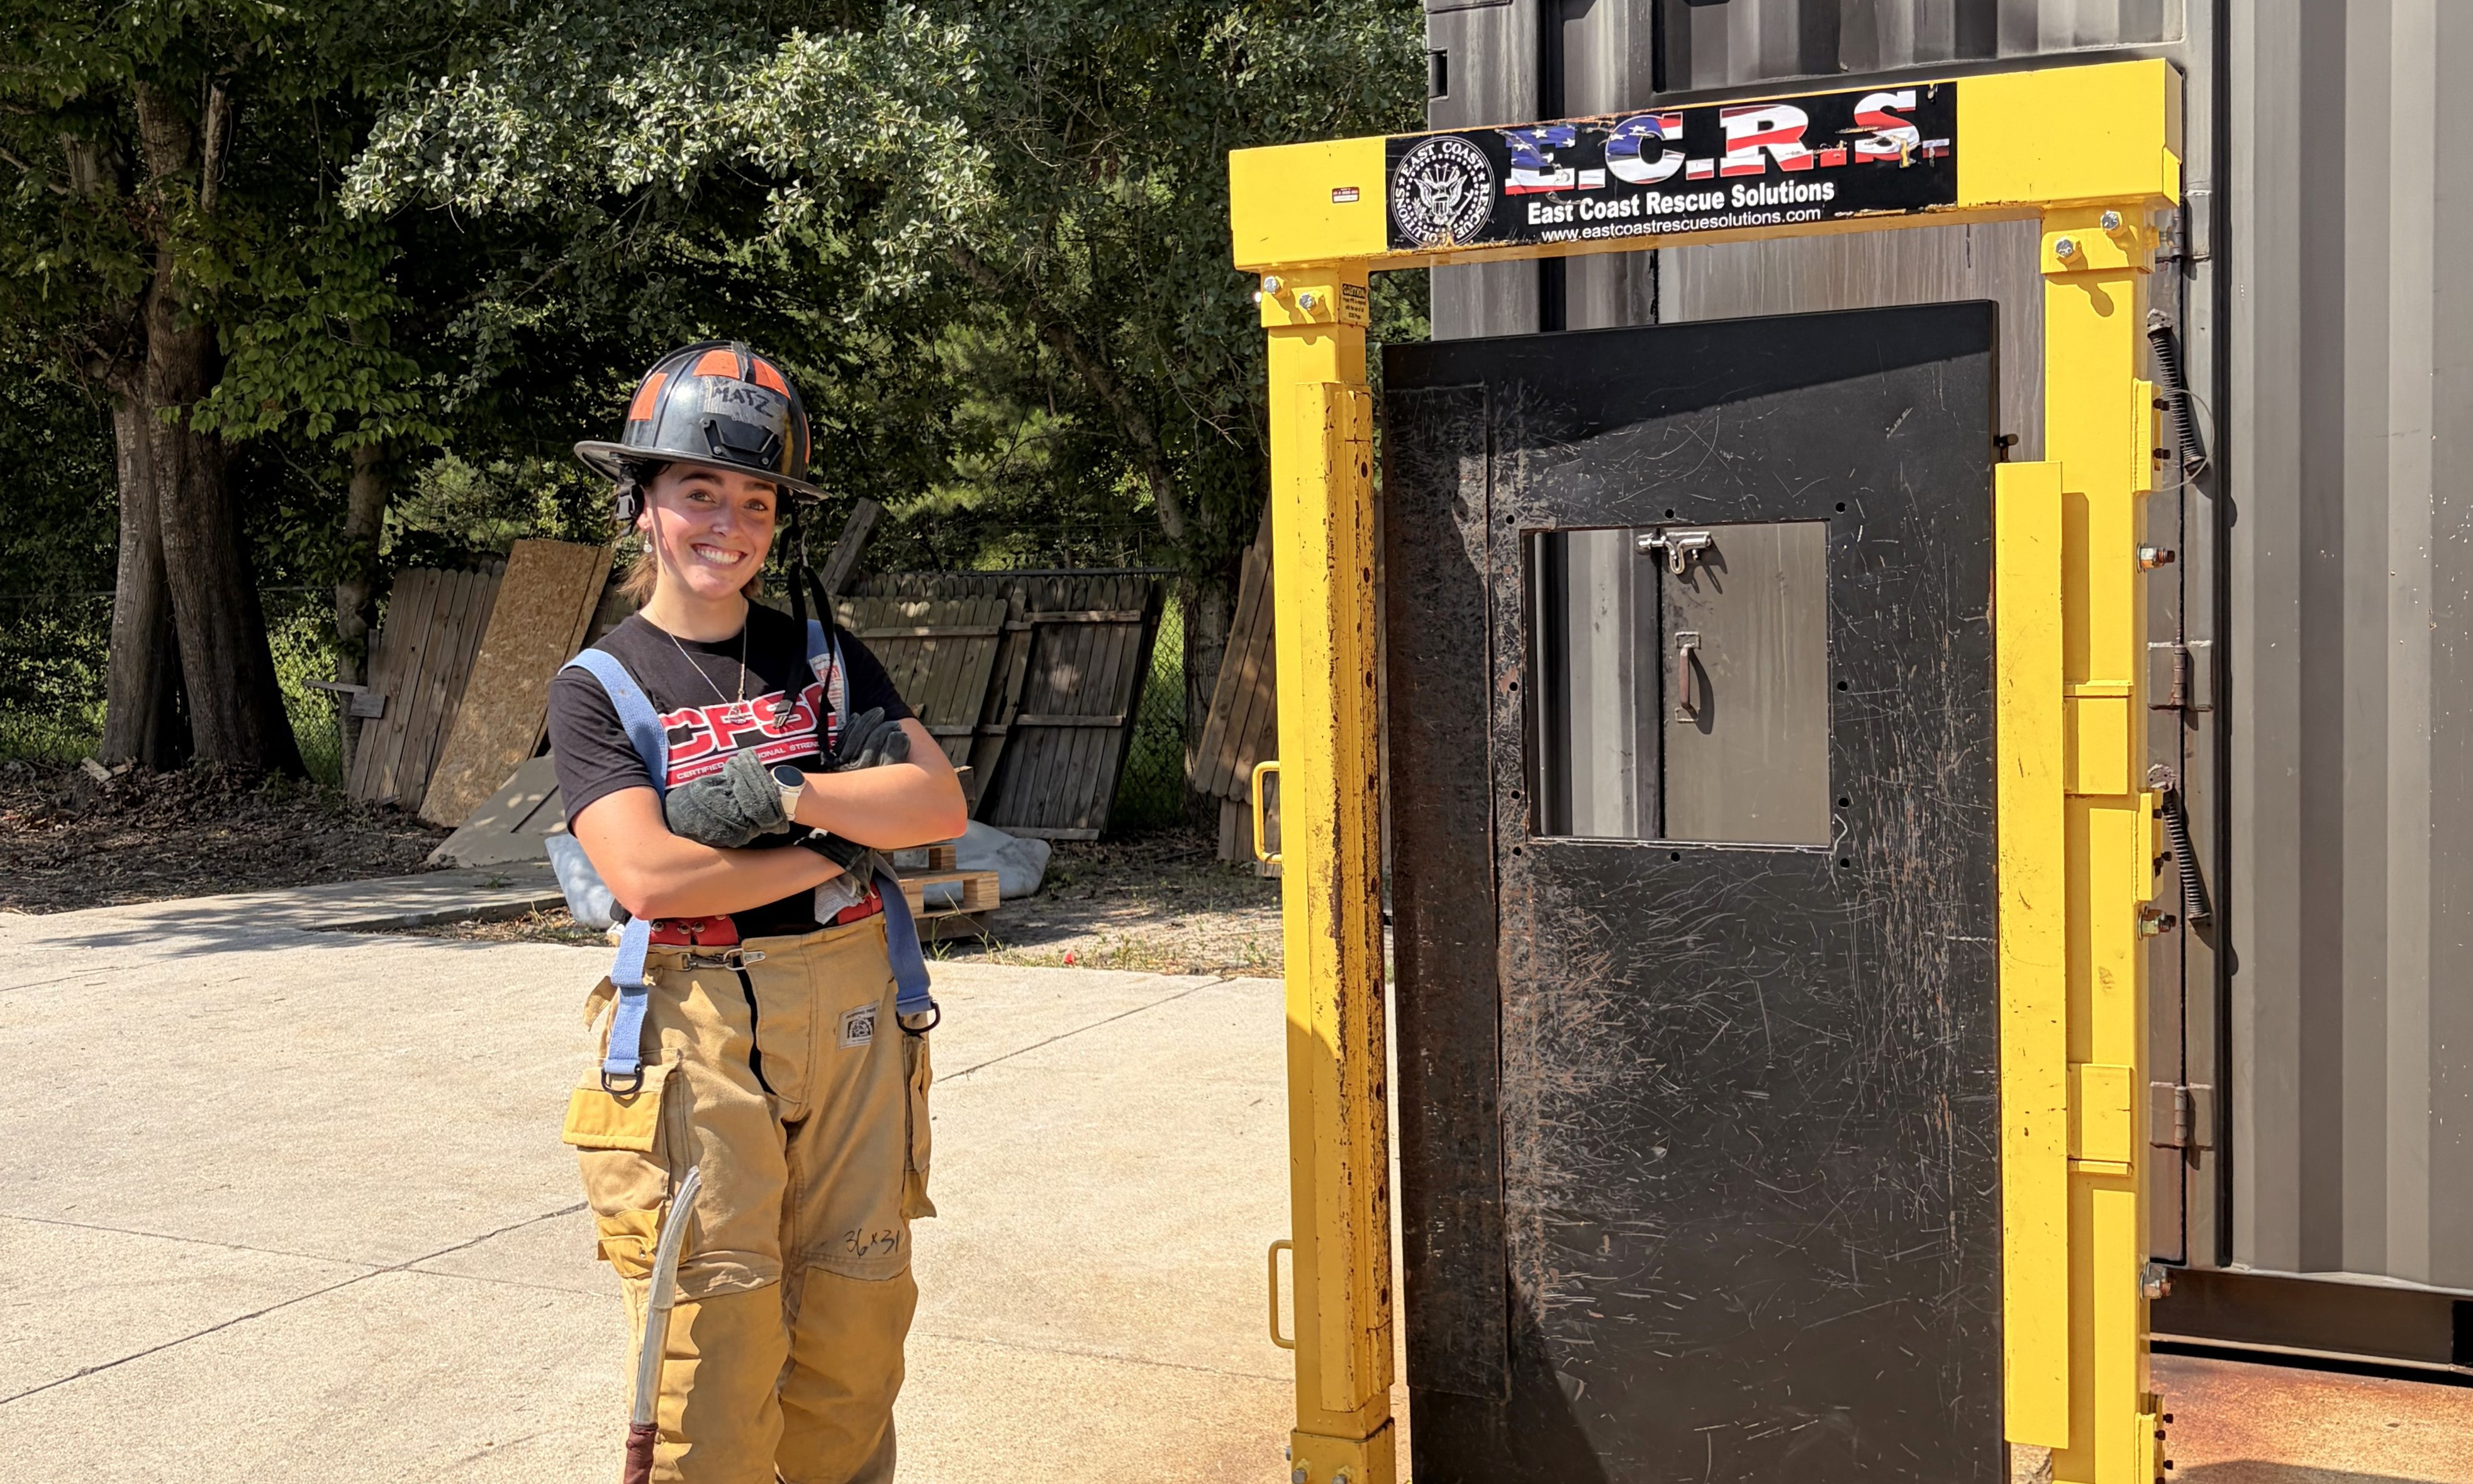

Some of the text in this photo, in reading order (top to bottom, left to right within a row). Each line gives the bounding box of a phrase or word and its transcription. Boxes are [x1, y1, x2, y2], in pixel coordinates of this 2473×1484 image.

[1400, 142, 1485, 177] EAST COAST
[1505, 89, 1950, 196] E.C.R.S.
[1454, 182, 1490, 239] RESCUE
[1527, 180, 1834, 225] East Coast Rescue Solutions
[1541, 208, 1821, 242] www.eastcoastrescuesolutions.com
[711, 386, 774, 418] MATZ
[677, 762, 725, 779] CERTIFIED
